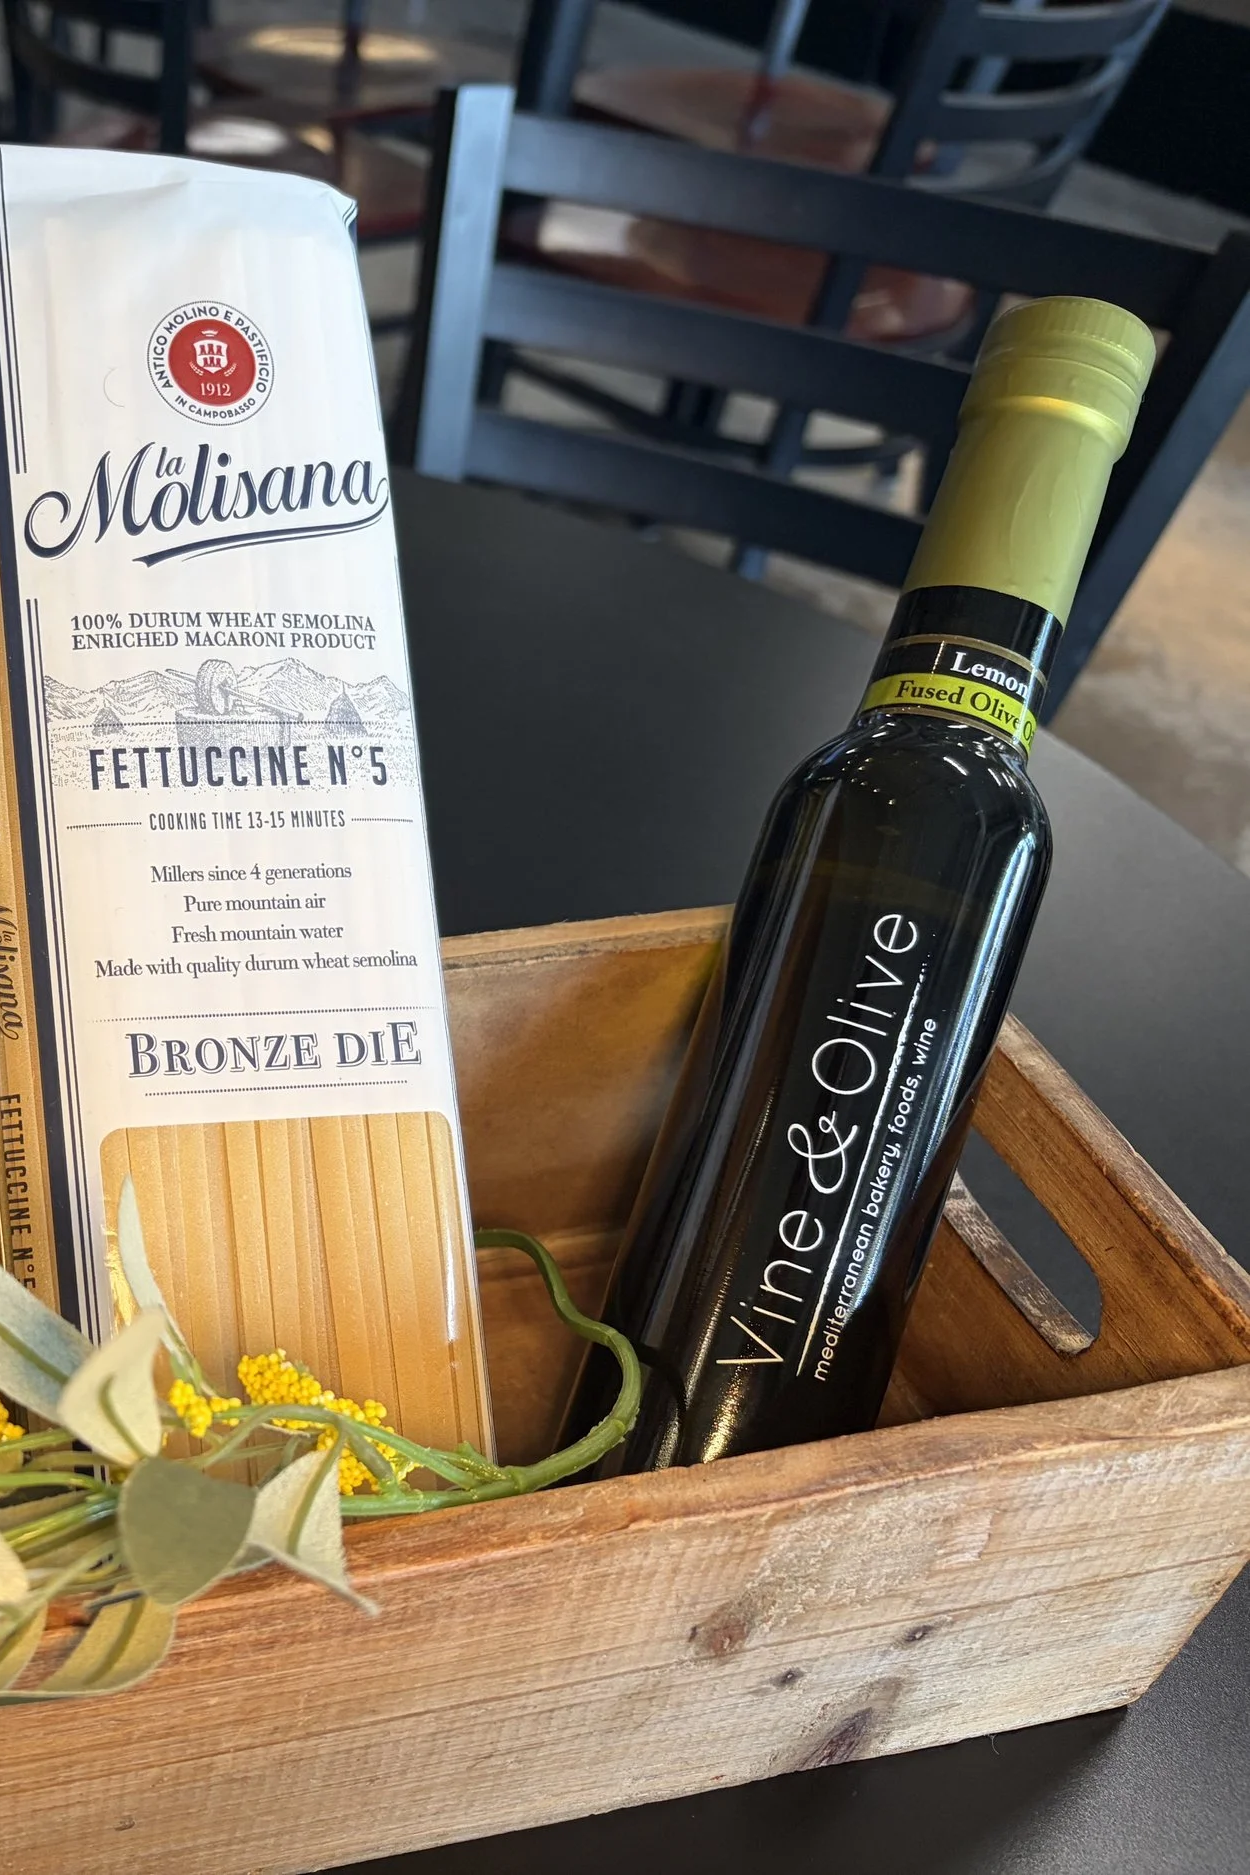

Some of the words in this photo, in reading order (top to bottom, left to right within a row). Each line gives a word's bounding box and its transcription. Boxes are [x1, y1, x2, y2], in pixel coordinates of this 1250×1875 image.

[153, 335, 173, 389] ANTICO
[163, 306, 219, 334] MOLINO
[224, 311, 233, 321] E
[235, 318, 269, 393] PASTIFICIO
[175, 395, 187, 407] IN
[188, 398, 255, 419] CAMPOBASSO
[200, 383, 231, 396] 1912
[155, 446, 186, 479] la
[24, 441, 389, 562] Molisana
[70, 614, 122, 631] 100%
[130, 612, 201, 629] DURUM
[206, 612, 276, 629] WHEAT
[282, 613, 376, 631] SEMOLINA
[72, 632, 178, 650] ENRICHED
[185, 631, 285, 648] MACARONI
[291, 633, 376, 649] PRODUCT
[950, 651, 1029, 698] Lemon
[895, 680, 965, 705] Fused
[970, 691, 1021, 729] Olive
[89, 746, 311, 790] FETTUCCINE
[149, 812, 206, 831] COOKING
[212, 811, 243, 830] TIME
[248, 811, 286, 829] 13-15
[291, 810, 346, 828] MINUTES
[150, 865, 205, 883] Millers
[207, 866, 247, 882] since
[250, 863, 261, 880] 4
[264, 863, 352, 886] generations
[183, 895, 223, 913] Pure
[225, 893, 302, 911] mountain
[304, 894, 326, 909] air
[2, 930, 15, 942] la
[171, 925, 217, 943] Fresh
[220, 924, 297, 942] mountain
[299, 925, 344, 940] water
[94, 959, 143, 978] Made
[146, 957, 182, 975] with
[186, 954, 242, 979] quality
[245, 954, 300, 972] durum
[302, 952, 351, 970] wheat
[352, 950, 417, 969] semolina
[810, 913, 918, 1096] Olive
[125, 1031, 321, 1079] BRONZE
[0, 1093, 31, 1236] FETTUCCINE
[787, 1110, 860, 1195] &
[814, 1232, 875, 1383] mediterranean
[866, 1142, 902, 1222] bakery,
[887, 1074, 922, 1139] foods,
[912, 1017, 937, 1068] wine
[715, 1208, 824, 1365] Vine
